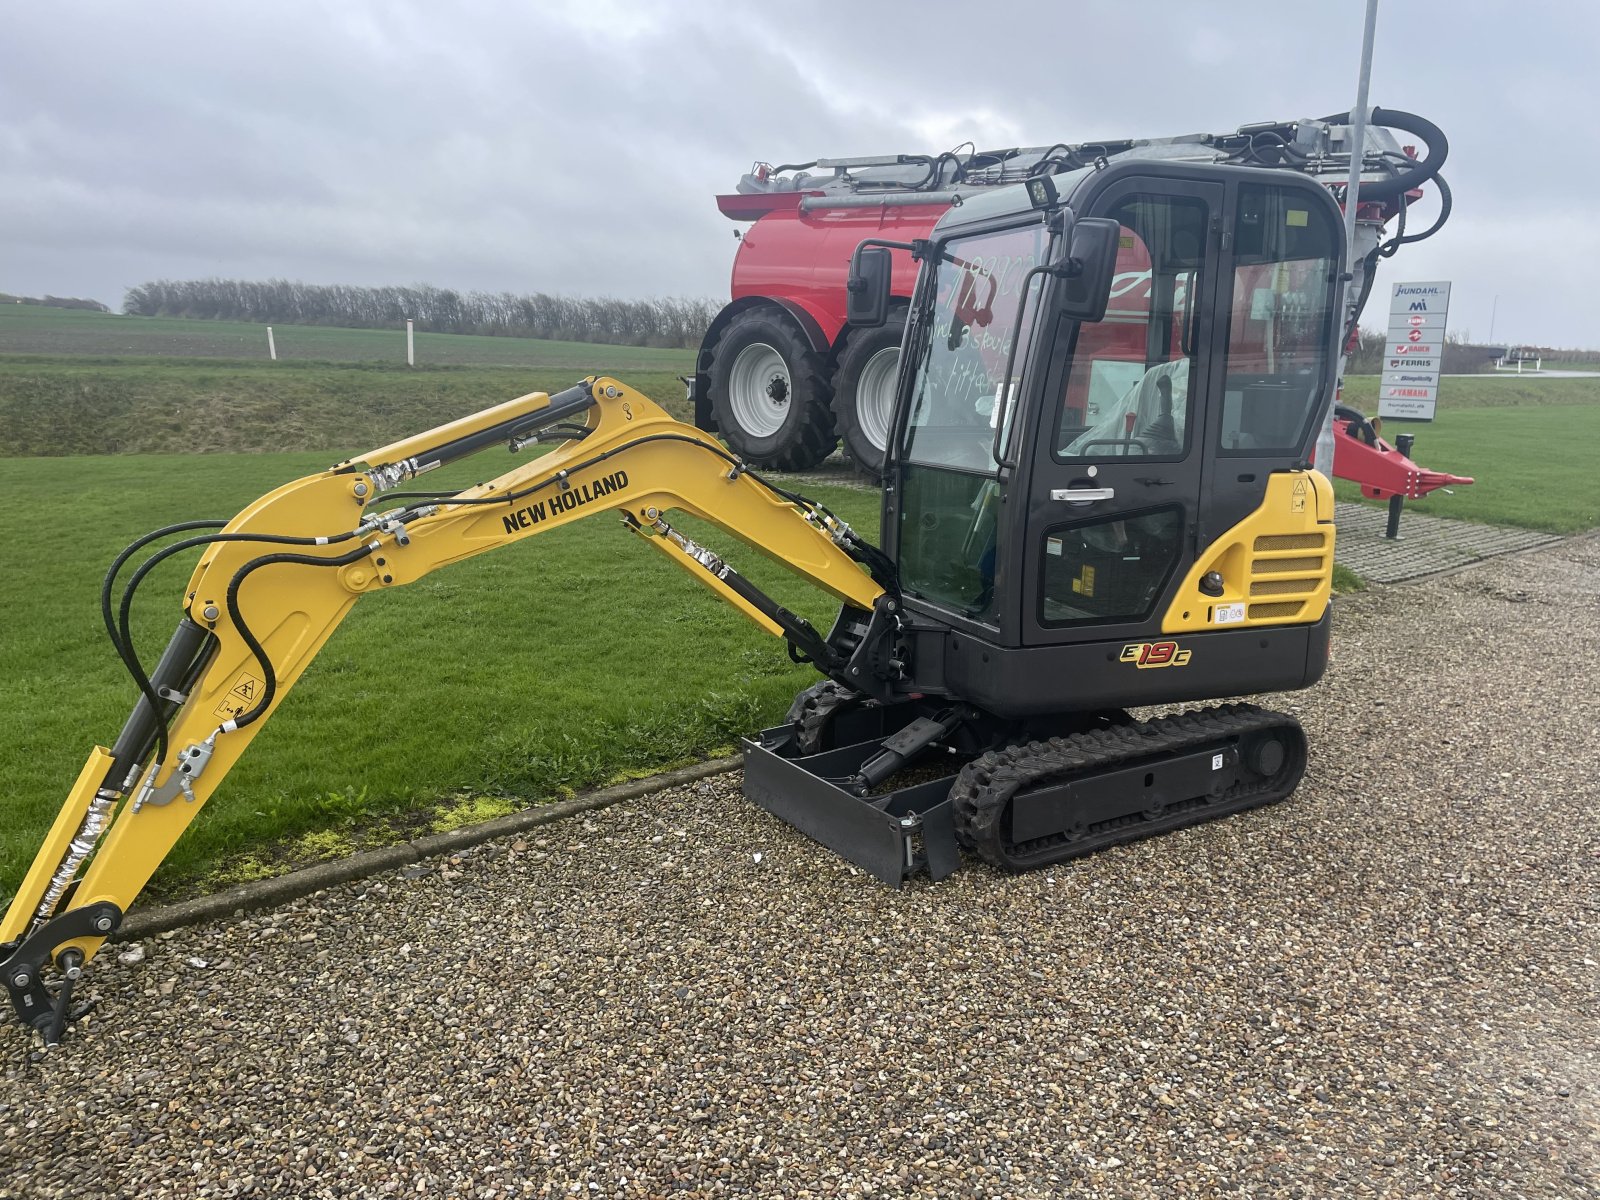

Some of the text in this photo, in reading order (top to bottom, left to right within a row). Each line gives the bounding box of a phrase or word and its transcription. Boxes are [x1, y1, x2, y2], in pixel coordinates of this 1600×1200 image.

[1400, 359, 1431, 367] FERRIS
[1397, 388, 1428, 398] YAMAHA
[502, 470, 629, 534] NEW HOLLAND
